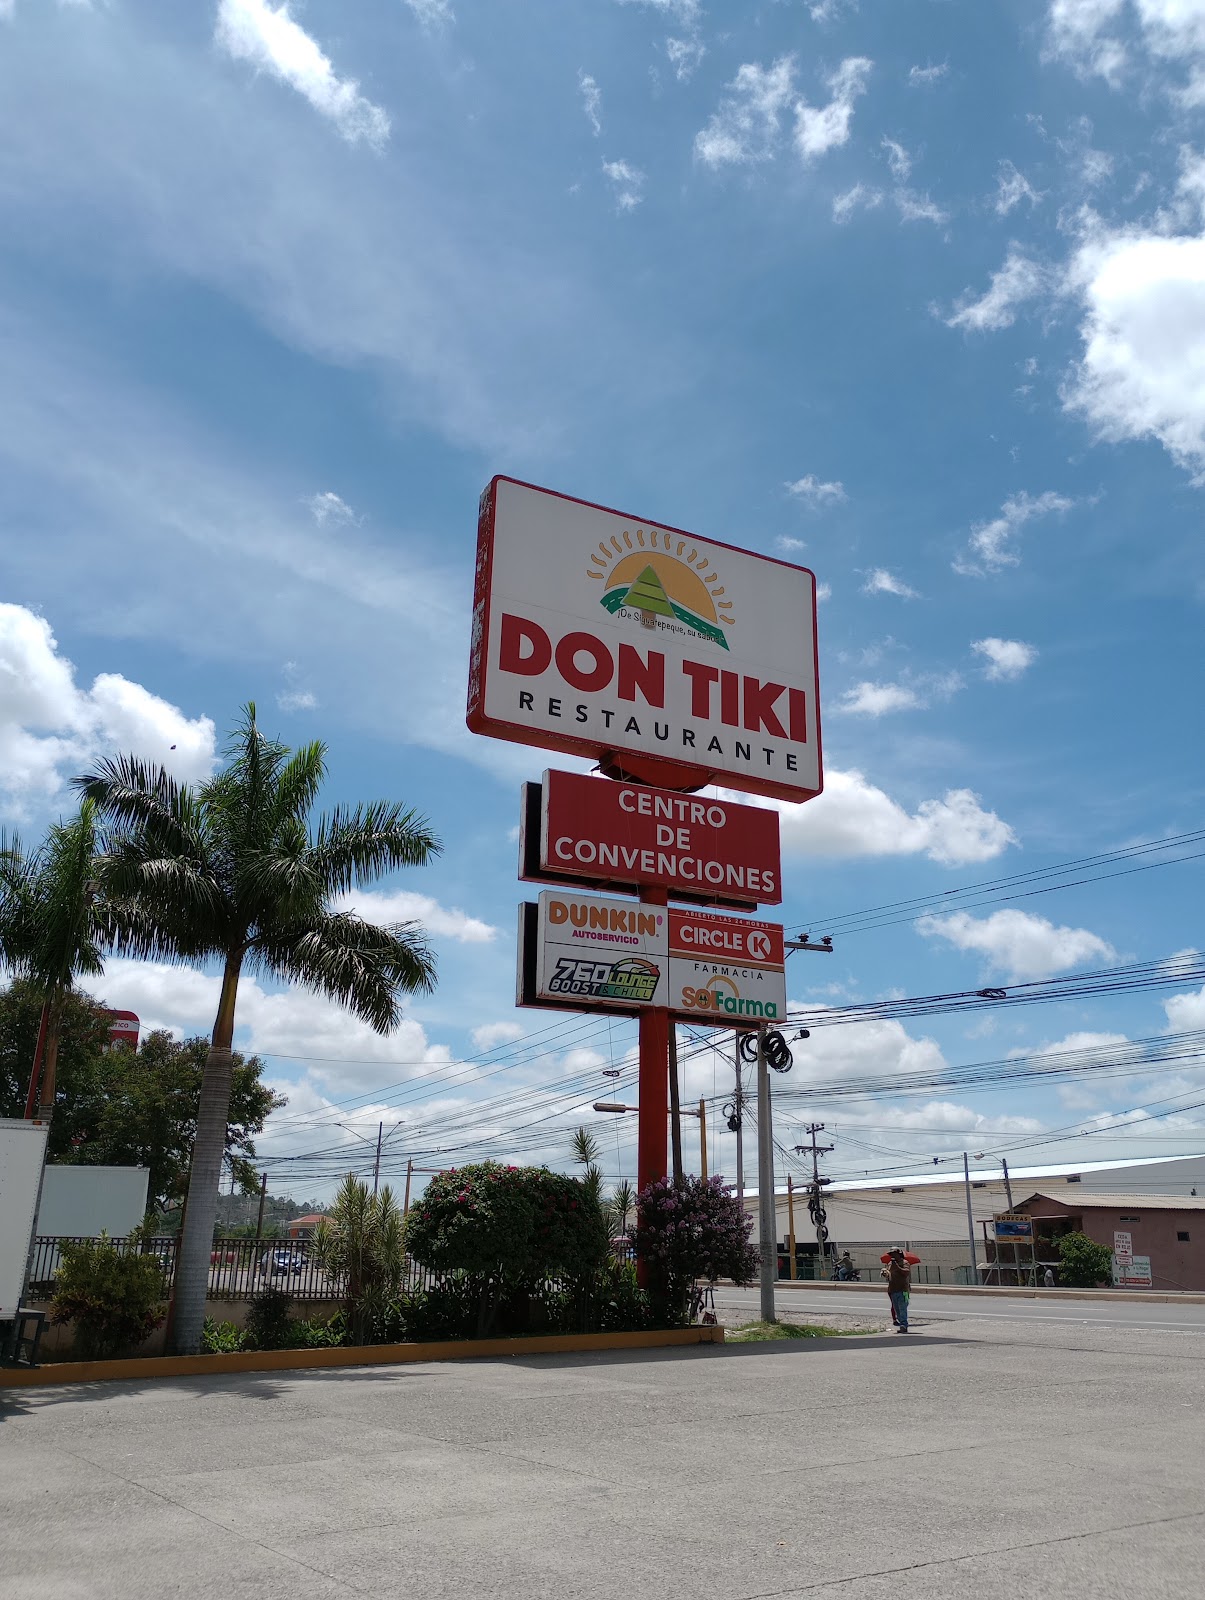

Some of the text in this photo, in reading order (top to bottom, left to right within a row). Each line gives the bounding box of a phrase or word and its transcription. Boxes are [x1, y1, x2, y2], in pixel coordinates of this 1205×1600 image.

[499, 612, 807, 743] DON TIKI
[519, 691, 798, 772] RESTAURANTE
[618, 789, 727, 828] CENTRO
[656, 824, 691, 850] DE
[555, 836, 775, 893] CONVENCIONES
[685, 911, 716, 920] ABIERTO
[746, 920, 769, 929] HORAS
[572, 929, 639, 945] AUTOSERVICIO
[680, 925, 771, 958] CIRCLE K
[607, 971, 658, 988] LOUNGE
[694, 963, 764, 981] FARMACIA
[550, 978, 651, 998] BOOST & CHILL
